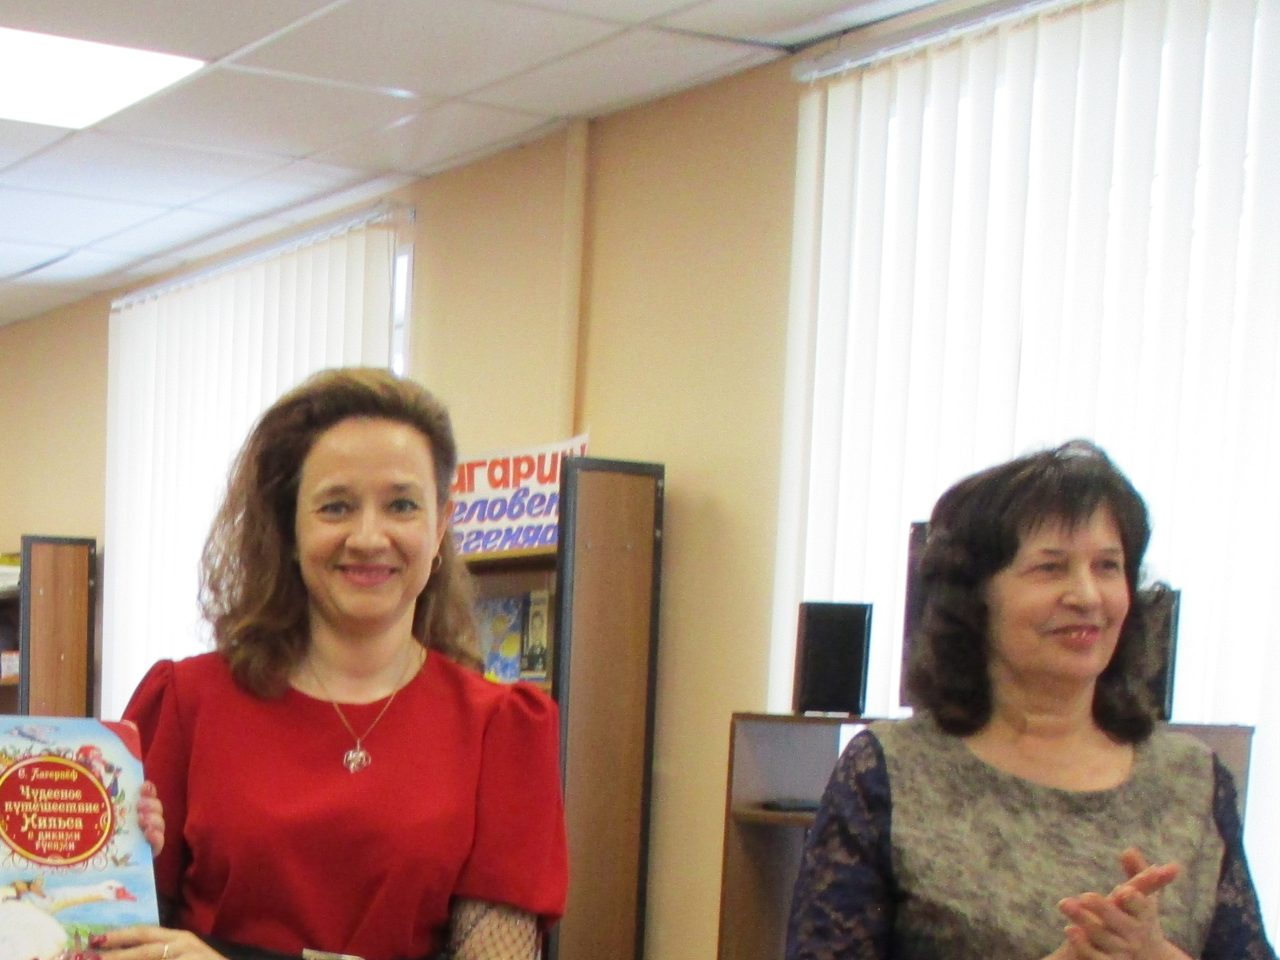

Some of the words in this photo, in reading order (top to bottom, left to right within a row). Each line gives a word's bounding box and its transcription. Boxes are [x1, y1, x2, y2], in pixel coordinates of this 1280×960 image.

[20, 785, 82, 803] Чудесное
[4, 800, 100, 815] путешествие
[21, 813, 84, 832] Нильса
[38, 831, 81, 841] дикими
